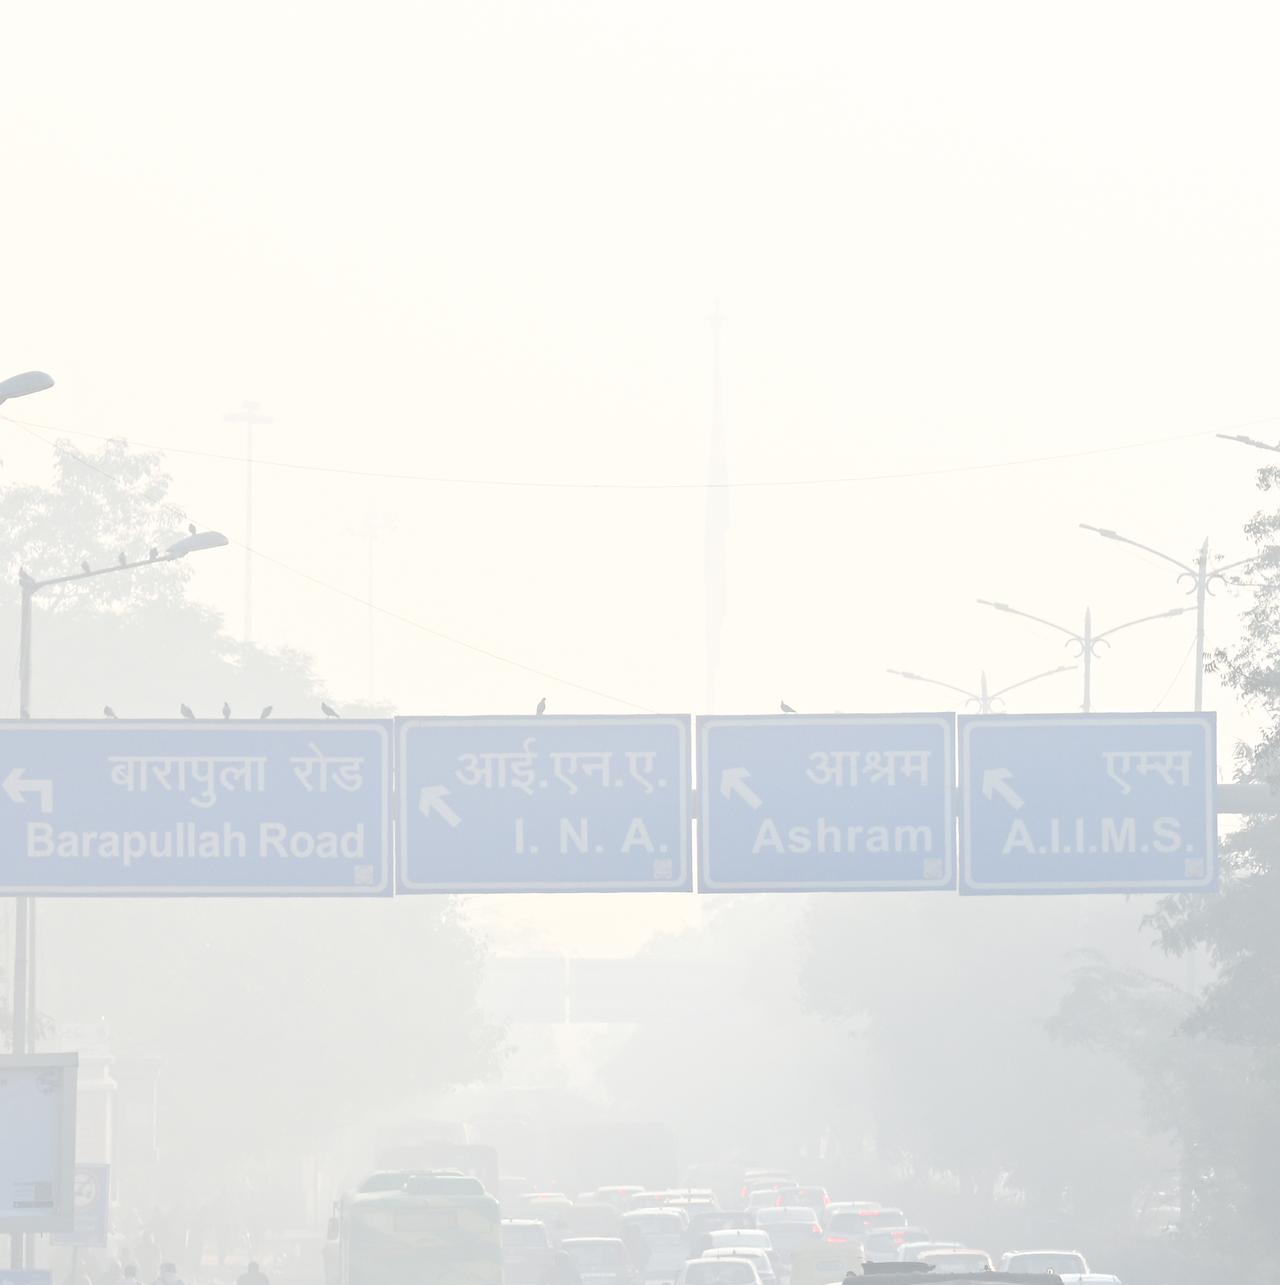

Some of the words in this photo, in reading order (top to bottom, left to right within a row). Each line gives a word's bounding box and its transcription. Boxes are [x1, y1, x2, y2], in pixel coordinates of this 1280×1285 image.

[108, 756, 267, 808] बारापुला
[290, 742, 365, 793] रोड
[805, 750, 932, 788] आश्रम
[1102, 750, 1194, 795] एम्स
[26, 822, 247, 866] Barapullah
[258, 822, 365, 859] Road
[751, 817, 933, 855] Ashram
[1002, 816, 1195, 856] A.I.I.M.S.
